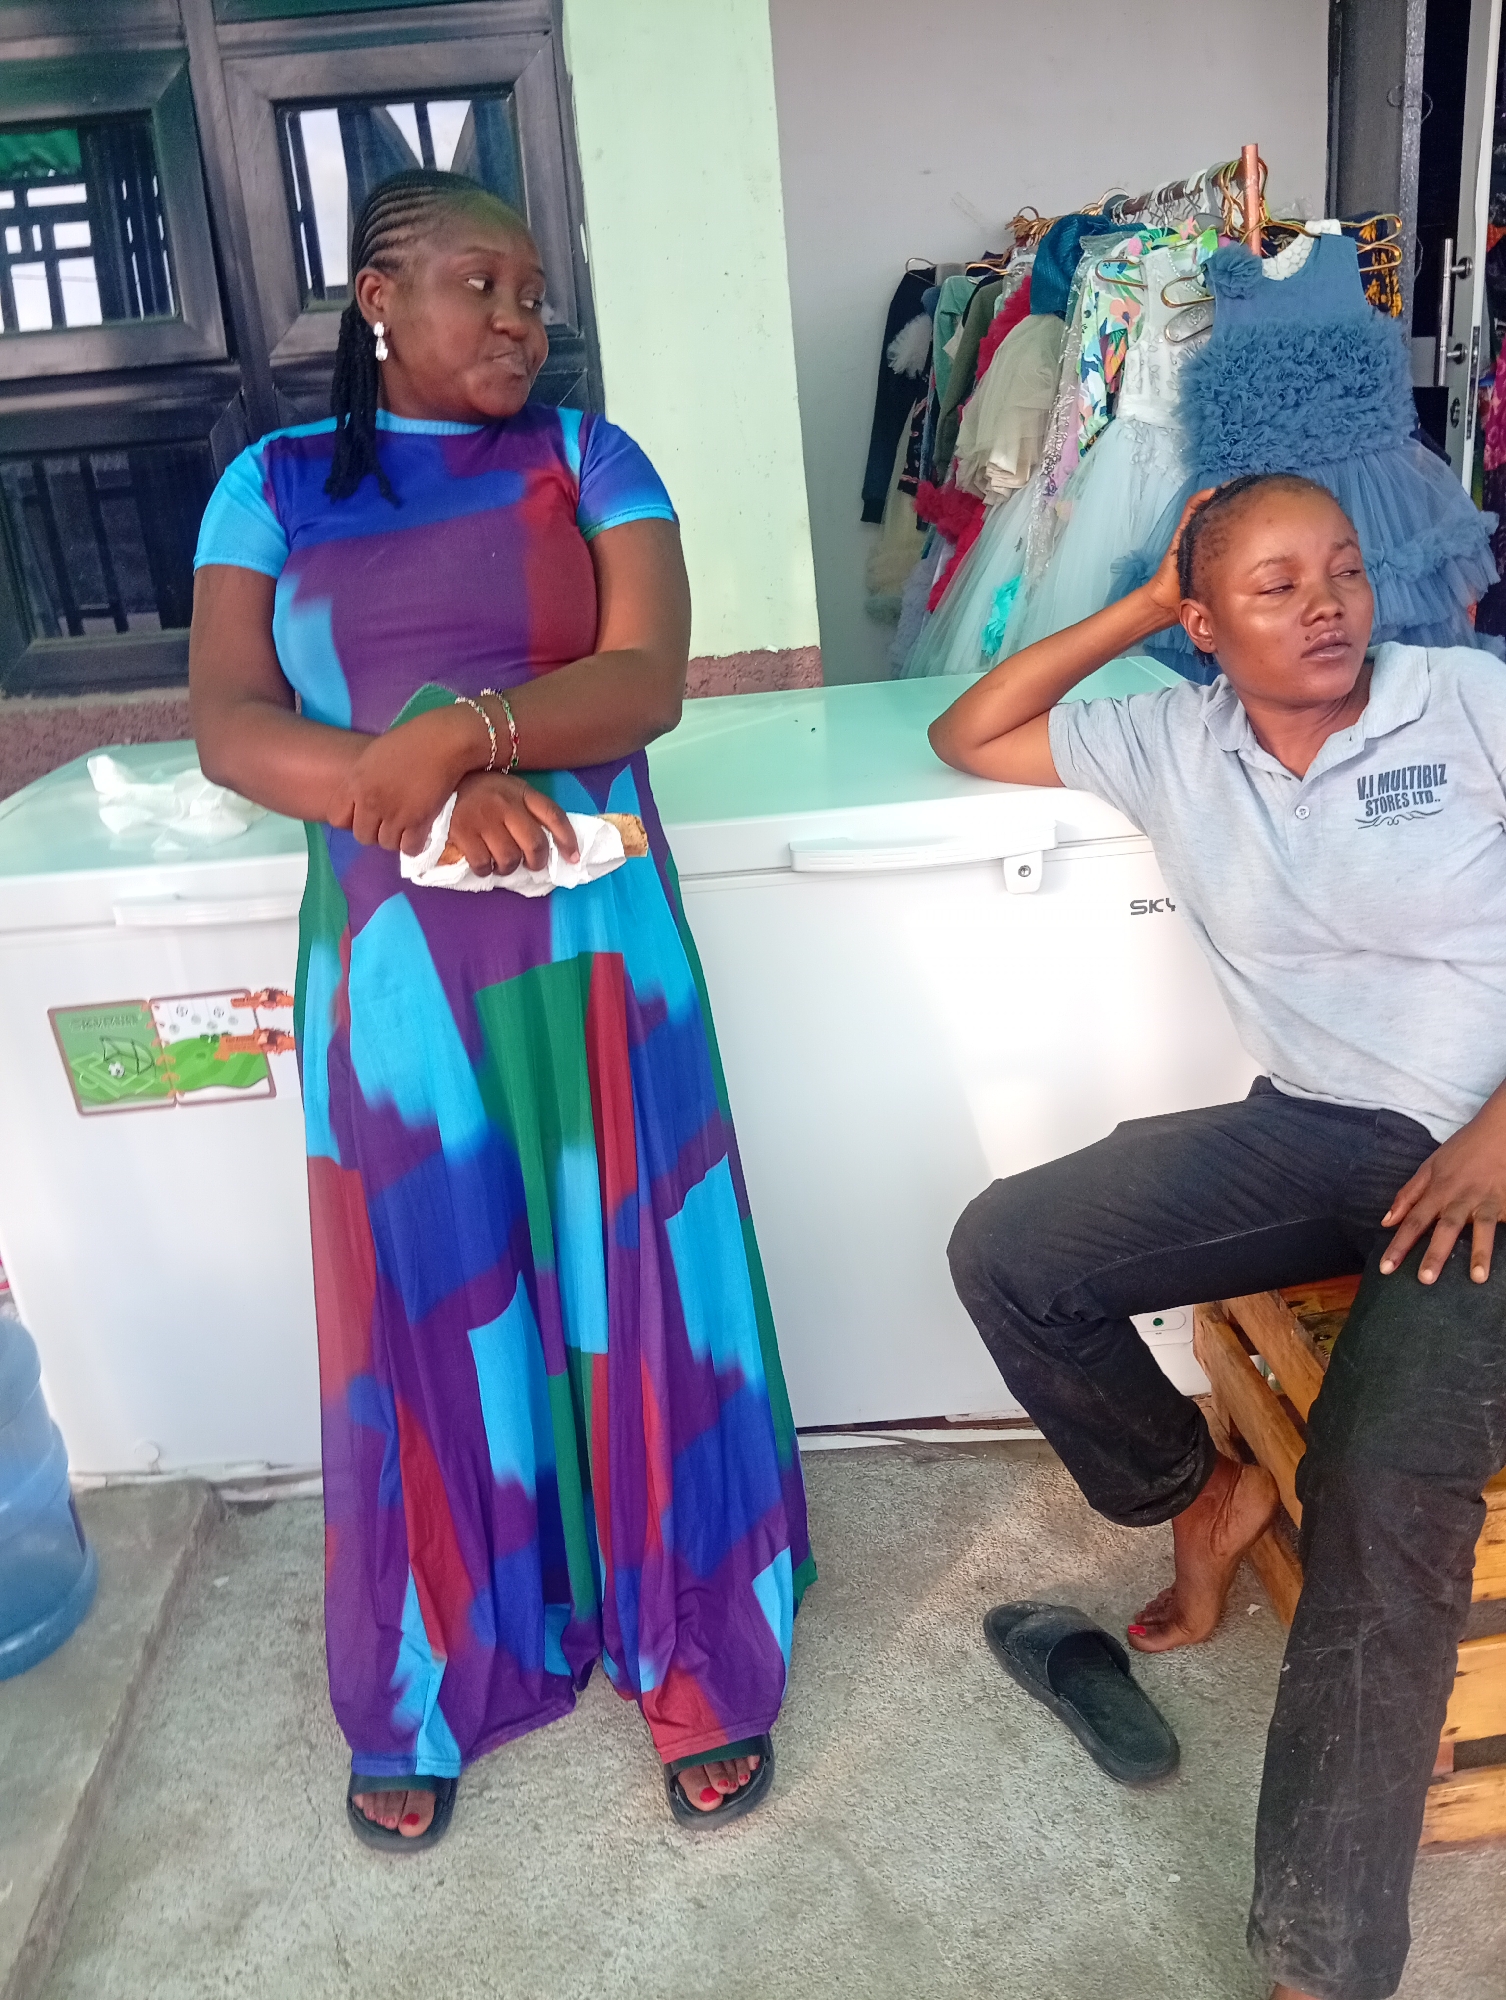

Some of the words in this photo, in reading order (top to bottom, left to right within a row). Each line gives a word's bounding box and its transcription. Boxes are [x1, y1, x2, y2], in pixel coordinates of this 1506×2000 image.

[1357, 774, 1374, 801] V.I
[1377, 763, 1448, 796] MULTIBIZ
[1365, 792, 1410, 817] STORES
